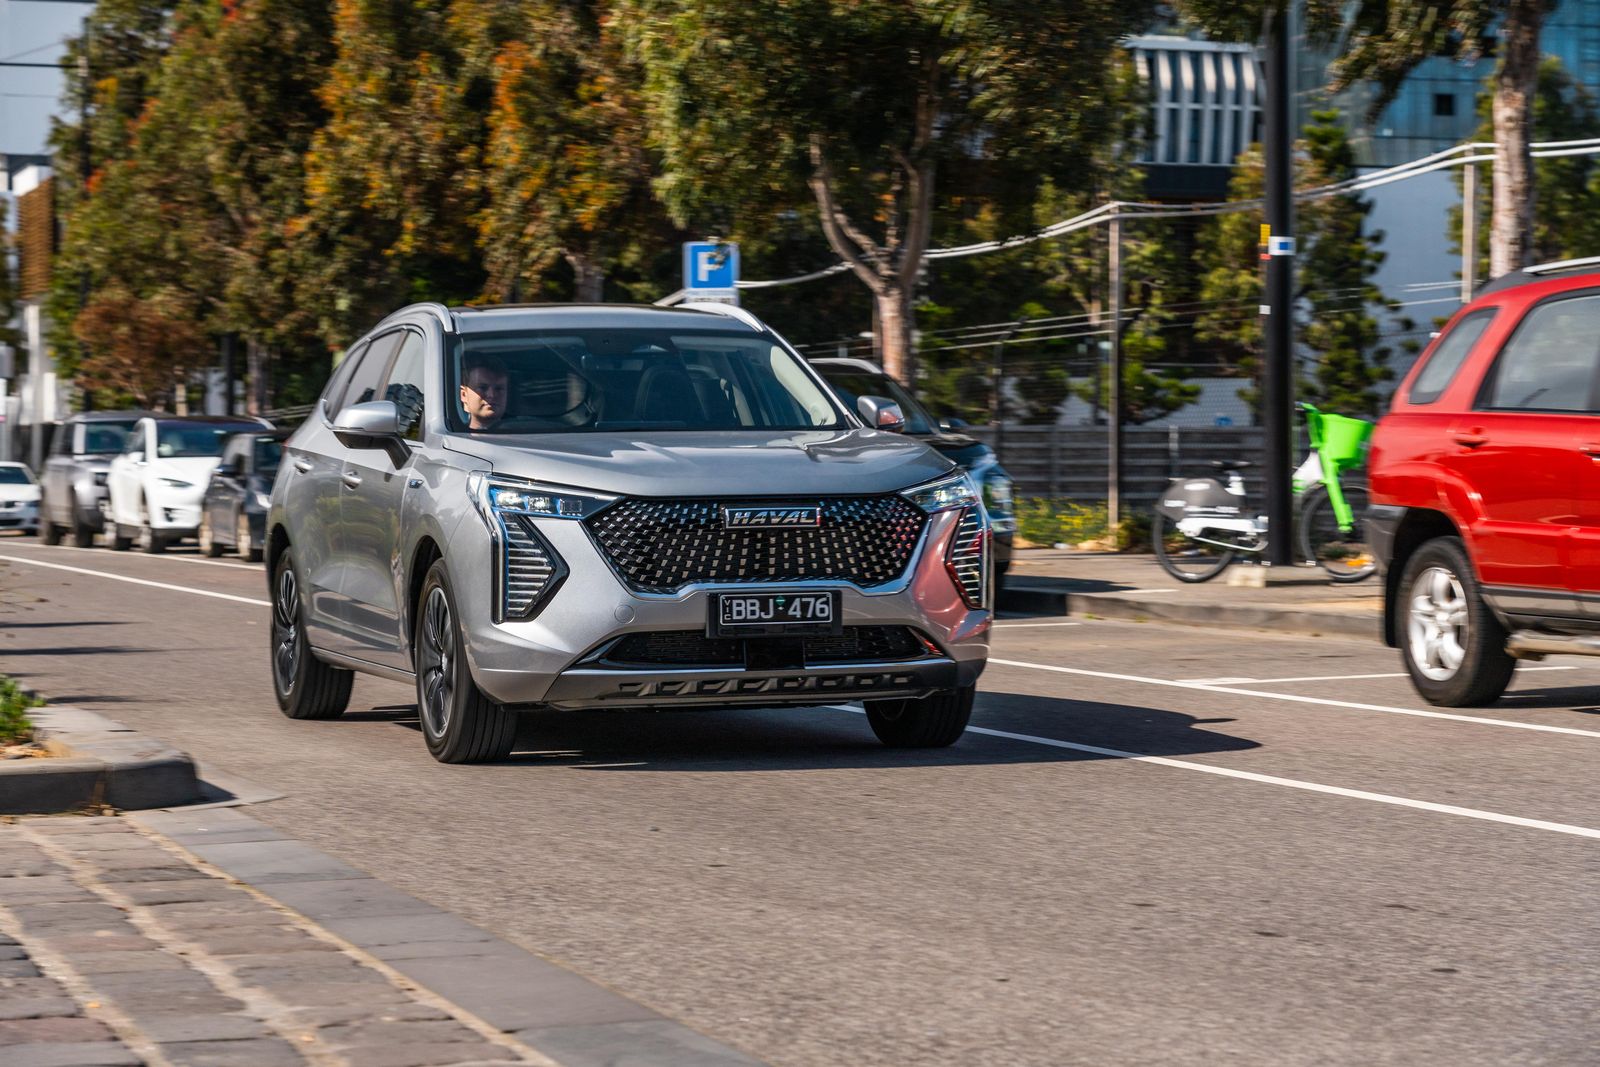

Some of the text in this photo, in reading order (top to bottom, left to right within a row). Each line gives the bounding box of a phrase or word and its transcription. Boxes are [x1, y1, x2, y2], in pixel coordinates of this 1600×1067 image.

[697, 251, 724, 282] P
[732, 511, 815, 524] HAVAL
[732, 597, 829, 620] BBJ 476
